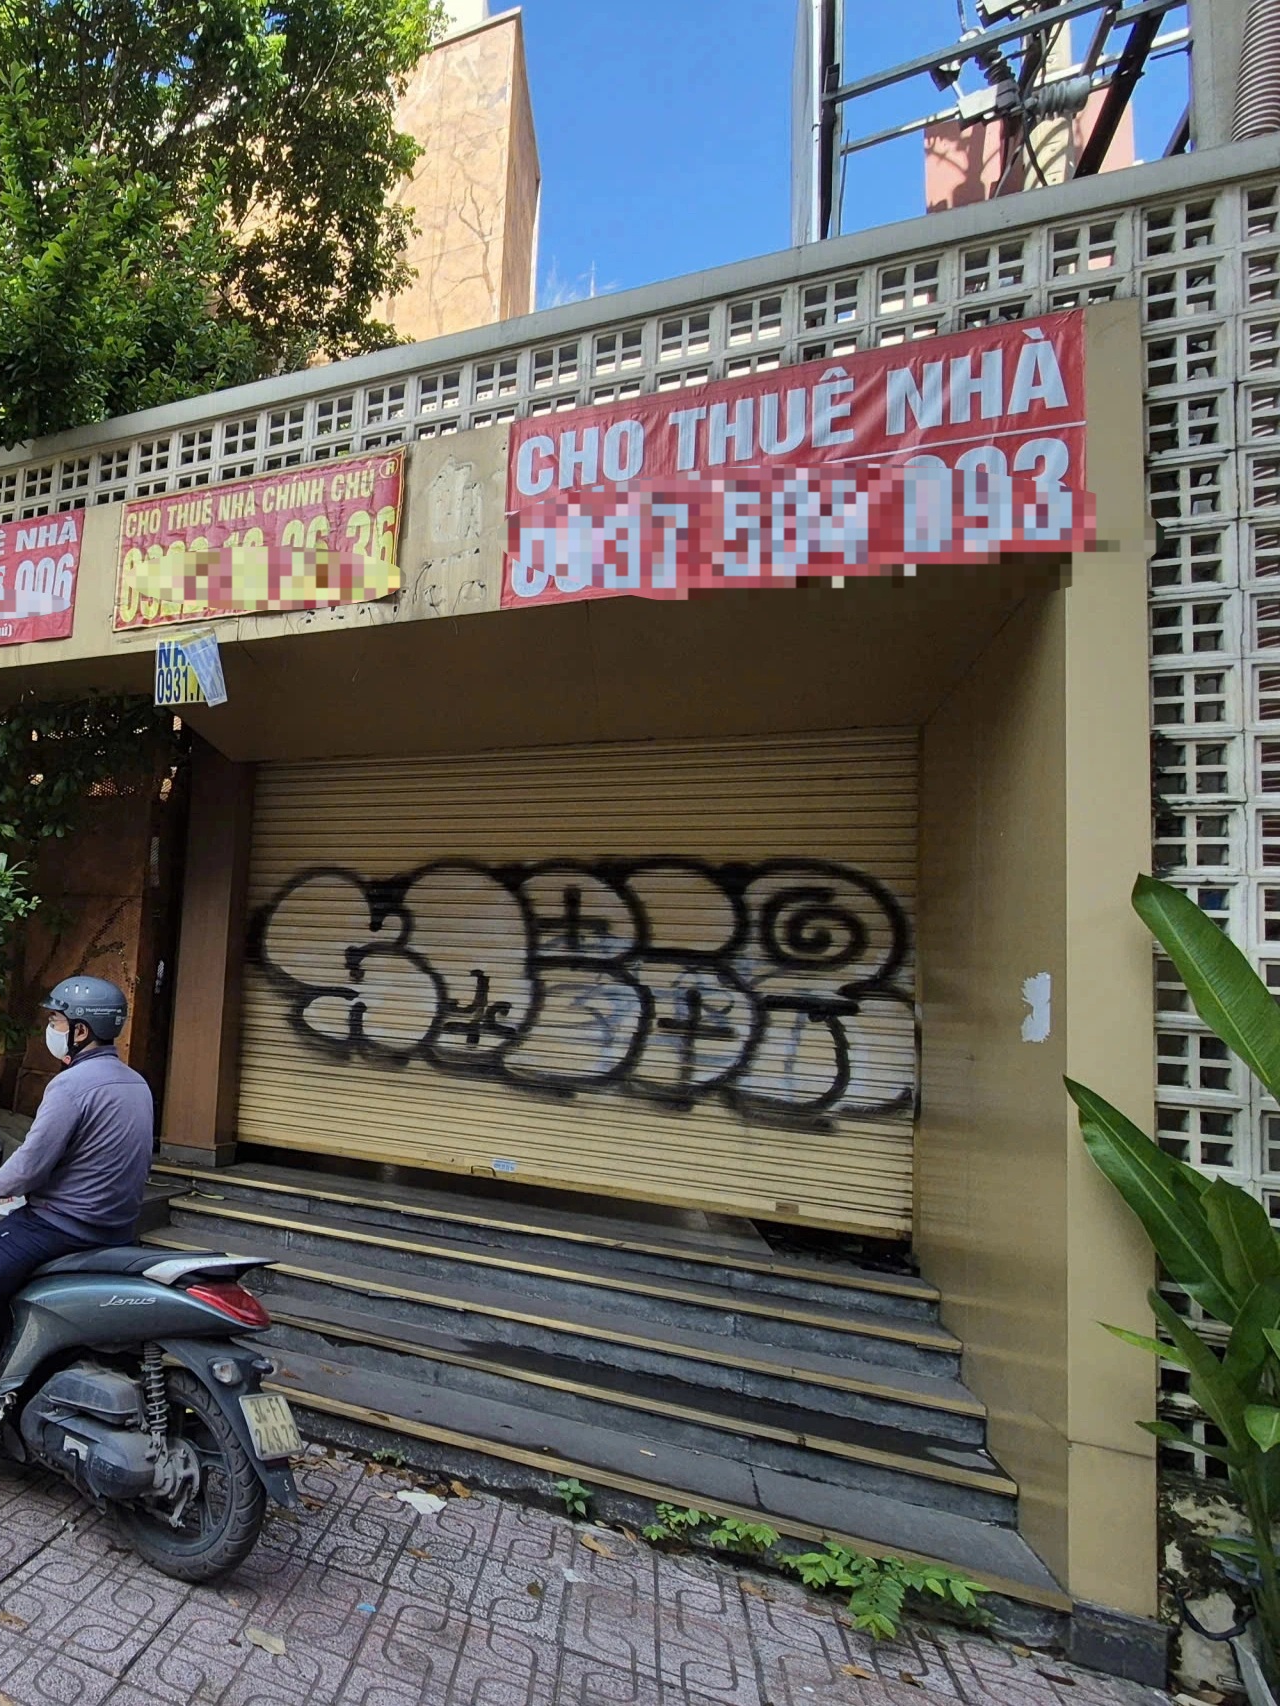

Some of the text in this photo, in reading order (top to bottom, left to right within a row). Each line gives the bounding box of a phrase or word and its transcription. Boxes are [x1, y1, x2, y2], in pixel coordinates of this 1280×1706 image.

[515, 327, 1069, 498] CHO THUÊ NHÀ
[125, 460, 375, 538] CHO THUÊ NHÀ CHÍNH CHỦ
[15, 516, 78, 552] NHÀ
[100, 1295, 156, 1307] Janus
